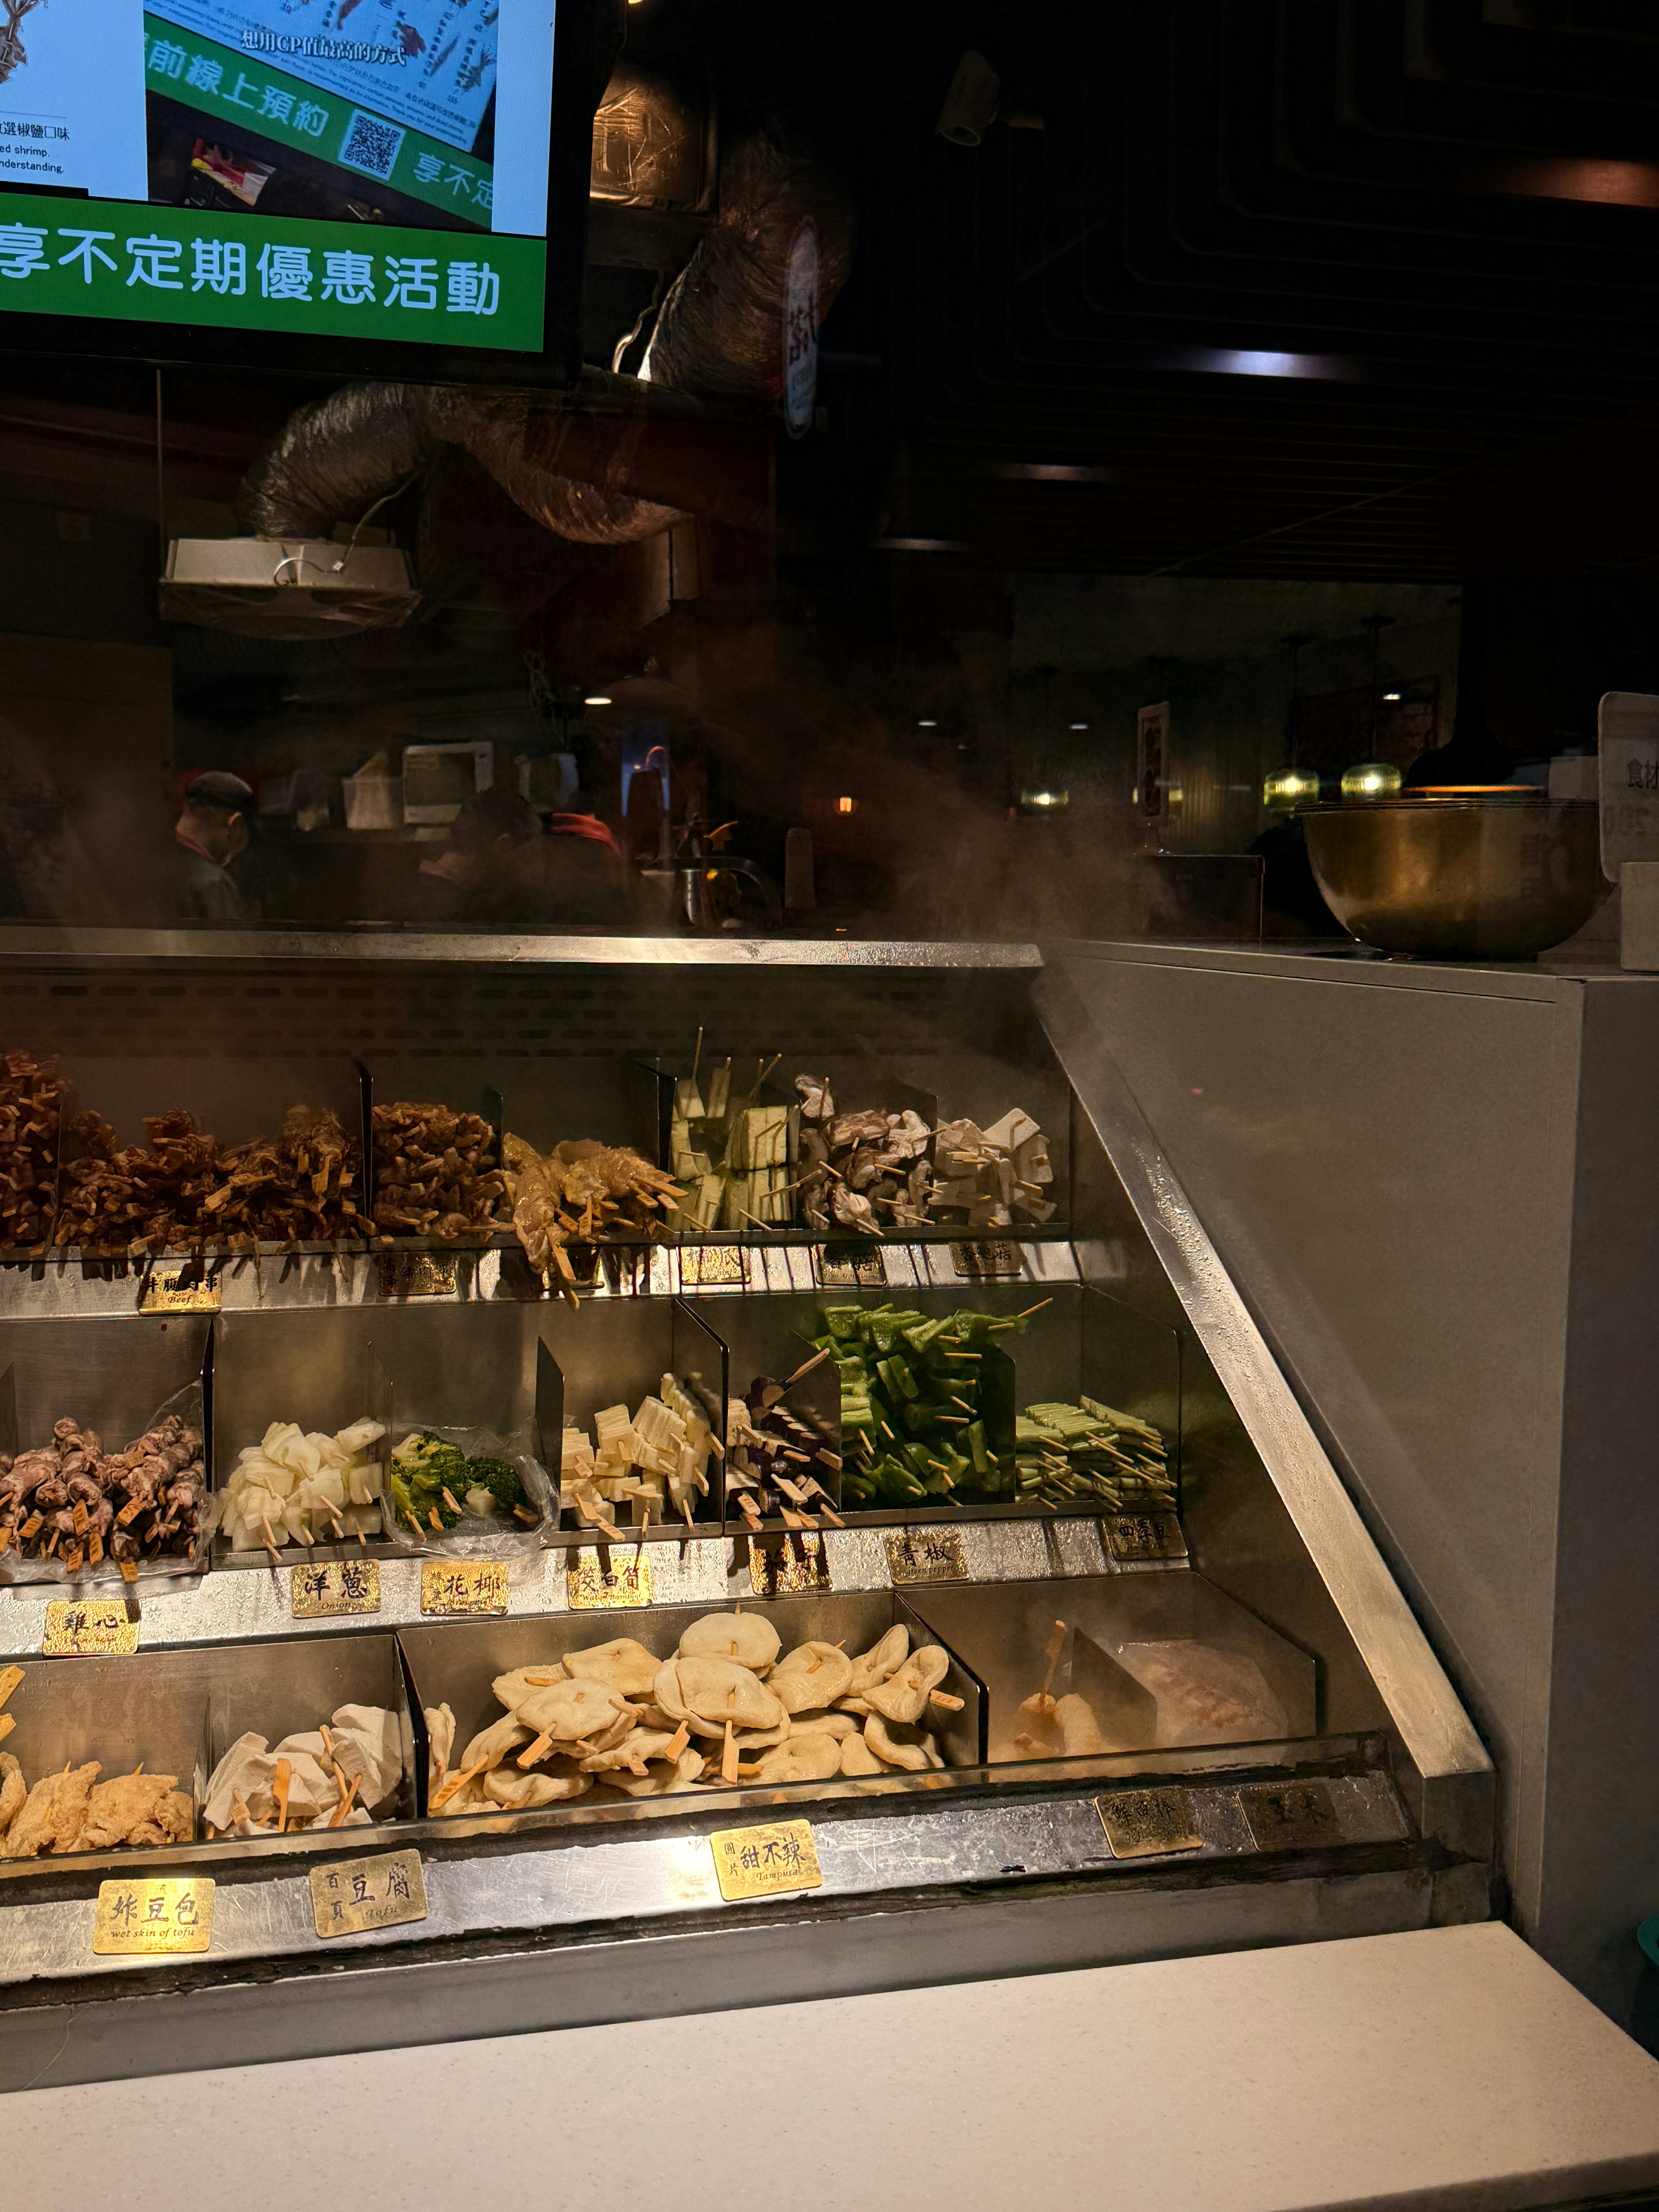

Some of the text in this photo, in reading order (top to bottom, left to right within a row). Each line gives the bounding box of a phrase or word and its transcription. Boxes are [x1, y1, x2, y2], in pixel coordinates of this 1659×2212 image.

[144, 32, 329, 137] 前線上預約
[15, 145, 50, 158] shrimp.
[0, 222, 500, 316] 享不定期優惠活動
[168, 1294, 193, 1305] Beef
[897, 1540, 955, 1567] 青椒
[906, 1566, 954, 1577] green pepper
[740, 1832, 807, 1870] 甜不辣
[349, 1862, 410, 1899] 豆腐
[110, 1892, 199, 1927] 炸豆包
[326, 1873, 344, 1920] 百頁
[366, 1904, 398, 1918] Tofu
[111, 1927, 194, 1939] wet skin of tofu
